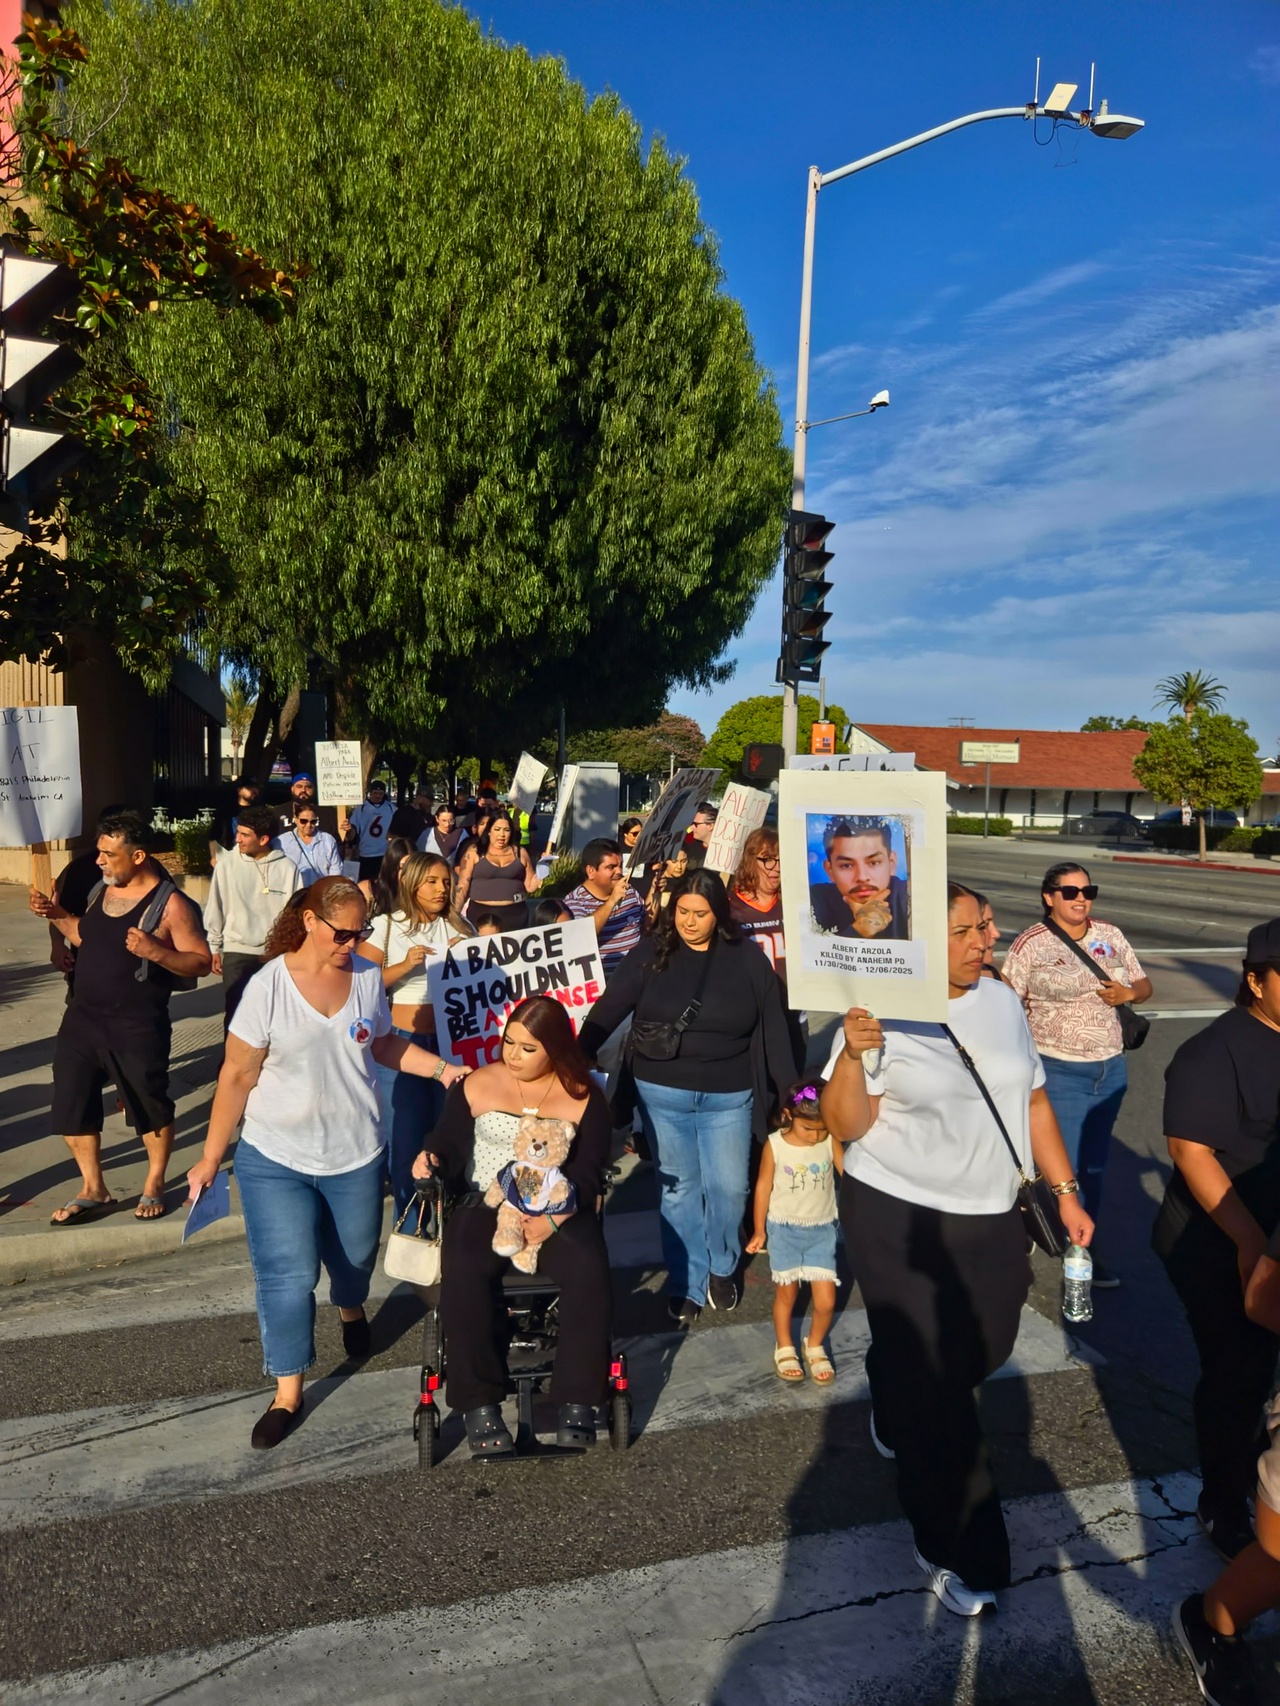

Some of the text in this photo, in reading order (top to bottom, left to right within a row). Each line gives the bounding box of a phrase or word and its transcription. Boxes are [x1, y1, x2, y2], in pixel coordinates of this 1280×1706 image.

[11, 743, 40, 764] AT
[21, 775, 70, 784] Philadelphia
[0, 791, 10, 801] St
[53, 793, 63, 801] CA
[369, 815, 383, 838] 6
[441, 927, 563, 980] A BADGE
[820, 951, 844, 960] KILLED
[857, 956, 893, 964] ANAHEIM
[894, 957, 905, 965] PD
[832, 943, 892, 955] ALBERT ARZOLA
[814, 959, 857, 972] 11/30/2006
[865, 966, 913, 975] 12/06/2025
[444, 953, 597, 1017] SHOULDN'T
[447, 1011, 480, 1042] BE
[484, 1006, 504, 1031] A
